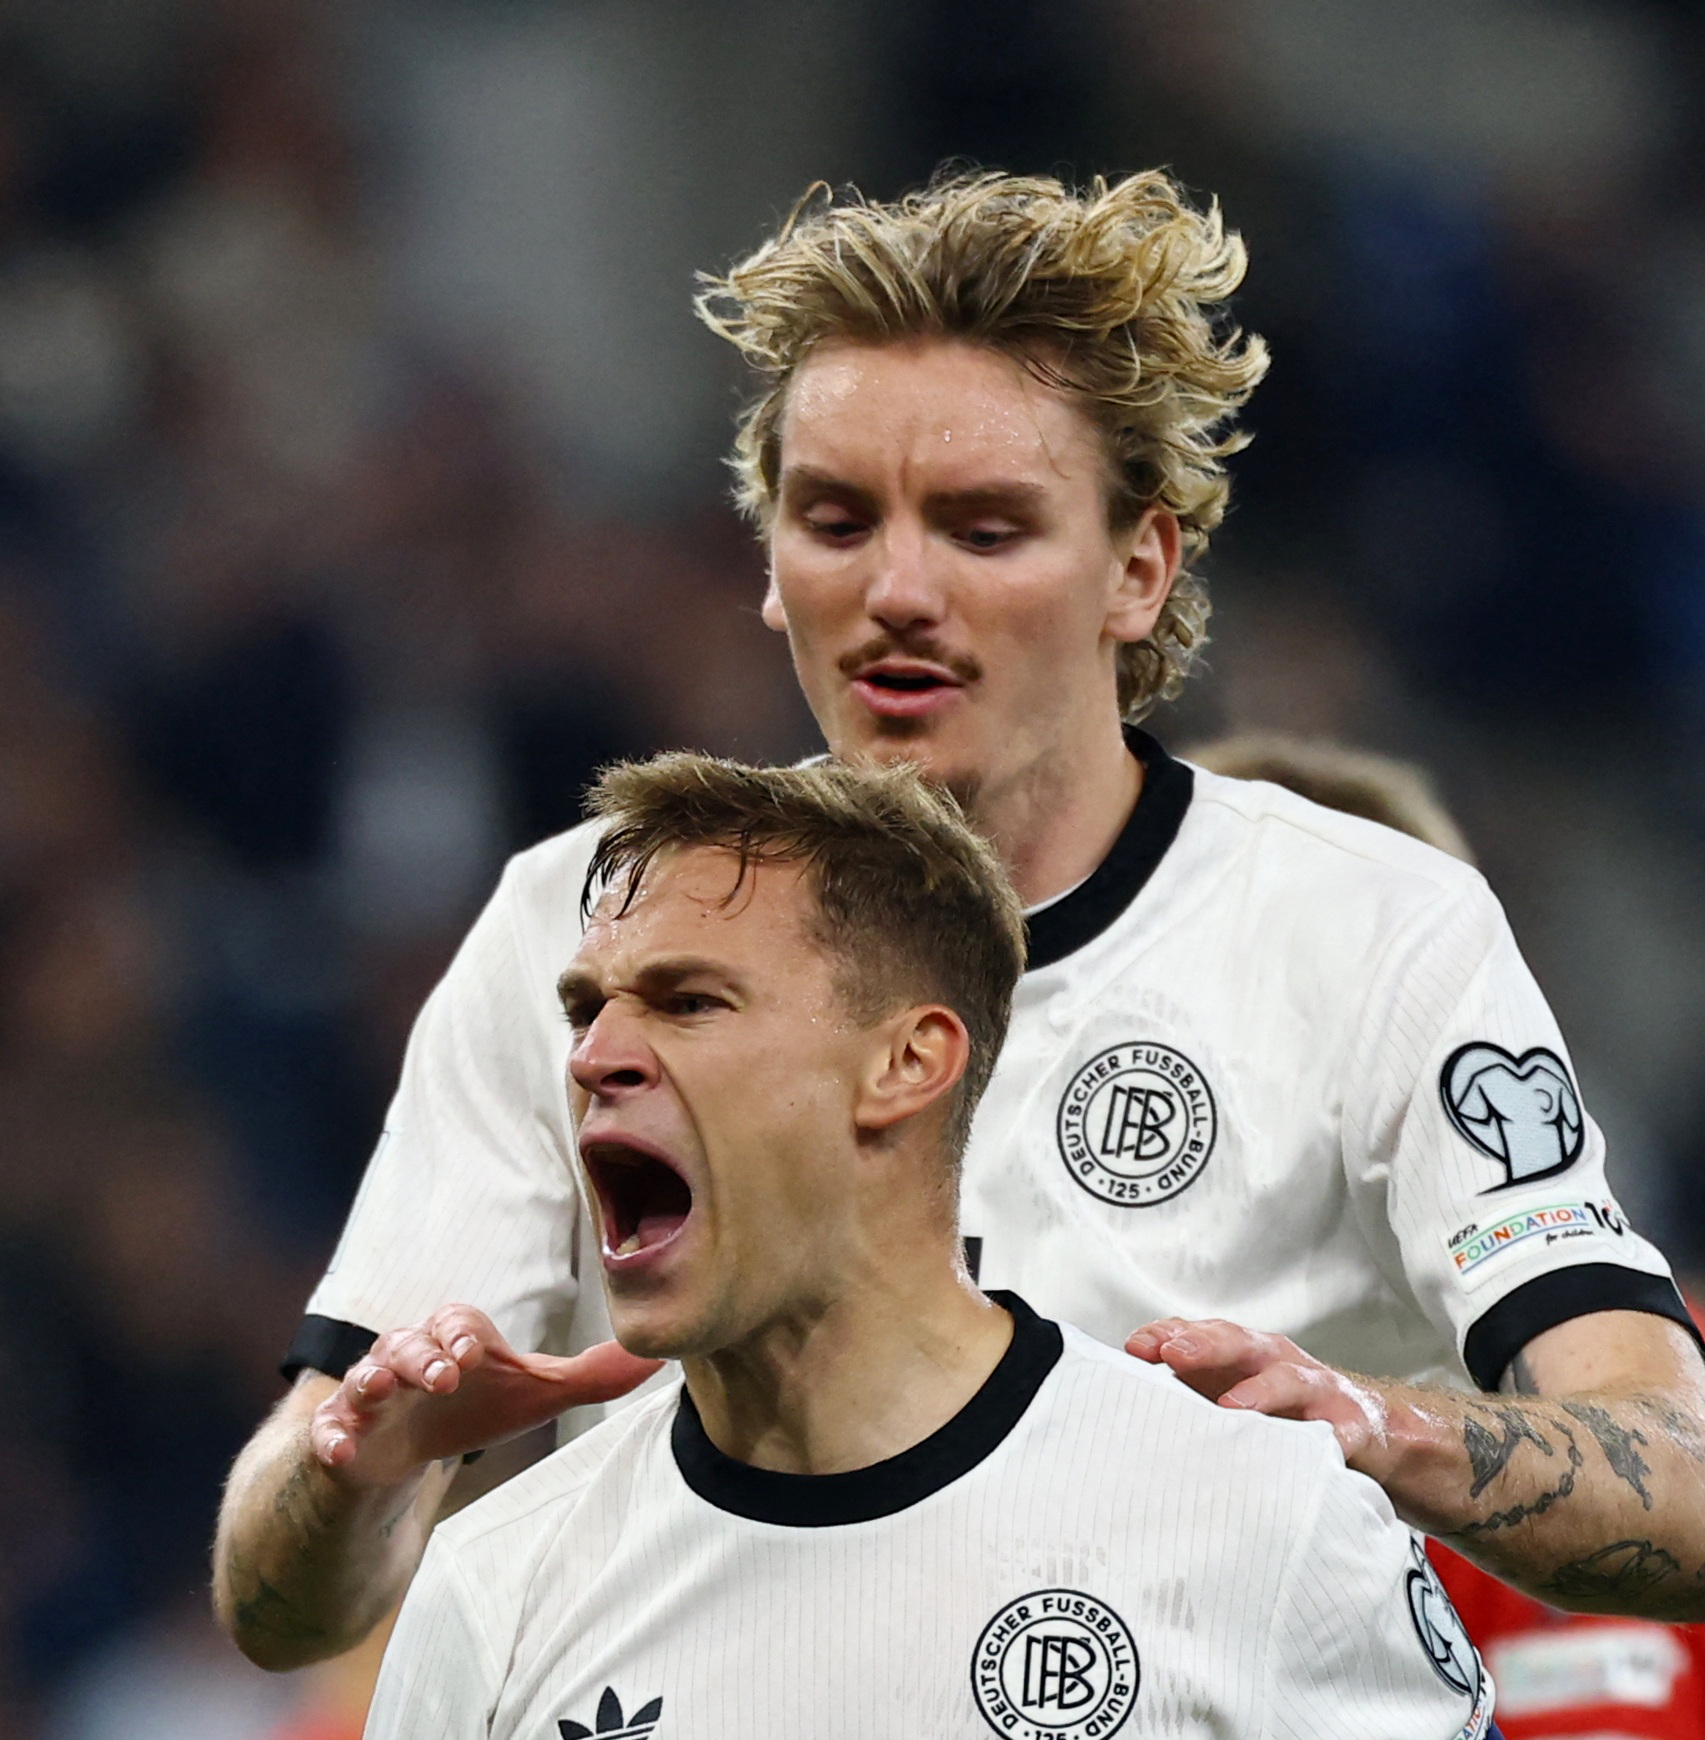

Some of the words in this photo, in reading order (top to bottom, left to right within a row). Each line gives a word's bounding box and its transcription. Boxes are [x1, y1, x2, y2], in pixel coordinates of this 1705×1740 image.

[1064, 1054, 1121, 1177] DEUTSCHER
[1132, 1049, 1208, 1190] FUSSBALL-BUND
[1107, 1178, 1140, 1199] 125
[1448, 1223, 1479, 1249] UEFA
[1454, 1207, 1587, 1270] FOUNDATION
[1545, 1231, 1559, 1246] for
[980, 1604, 1032, 1731] DEUTSCHER
[1042, 1597, 1132, 1738] FUSSBALL-BUND
